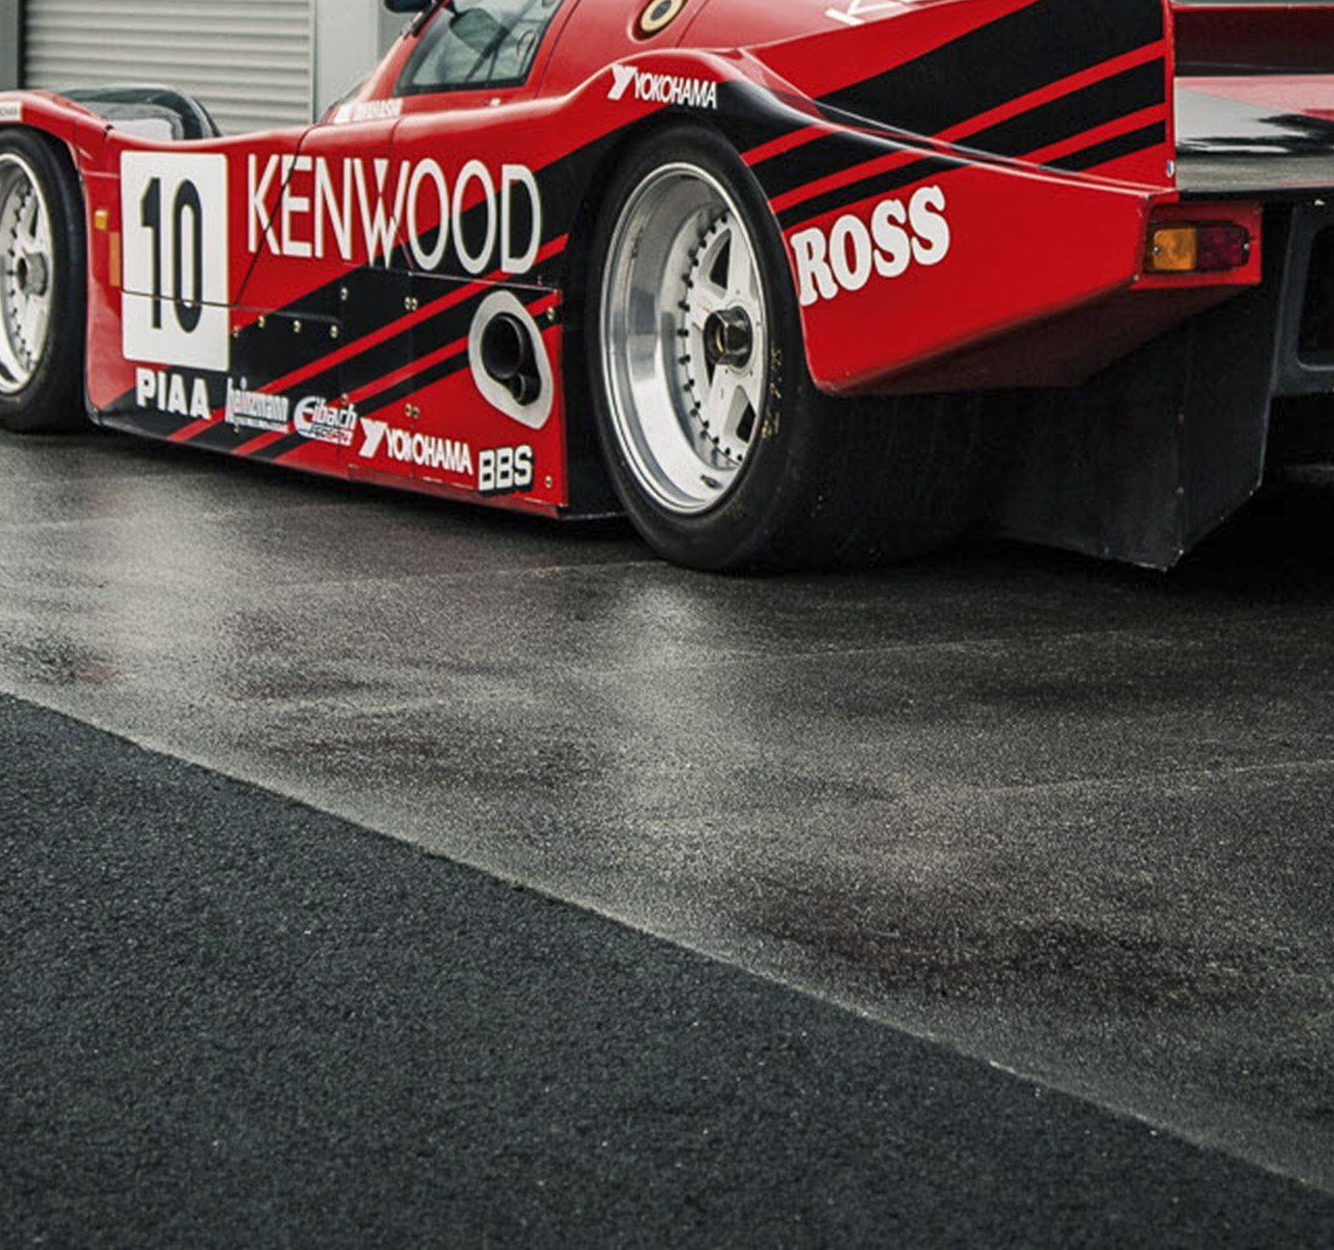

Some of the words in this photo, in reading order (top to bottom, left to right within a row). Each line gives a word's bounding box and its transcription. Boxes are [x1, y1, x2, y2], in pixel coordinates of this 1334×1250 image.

[634, 72, 718, 110] YOKOHAMA
[247, 153, 542, 274] KENWOOD
[140, 177, 203, 333] 10
[789, 185, 951, 306] ROSS
[136, 368, 210, 419] PIAA
[384, 427, 474, 476] YOKOHAMA
[478, 444, 534, 492] BBS
